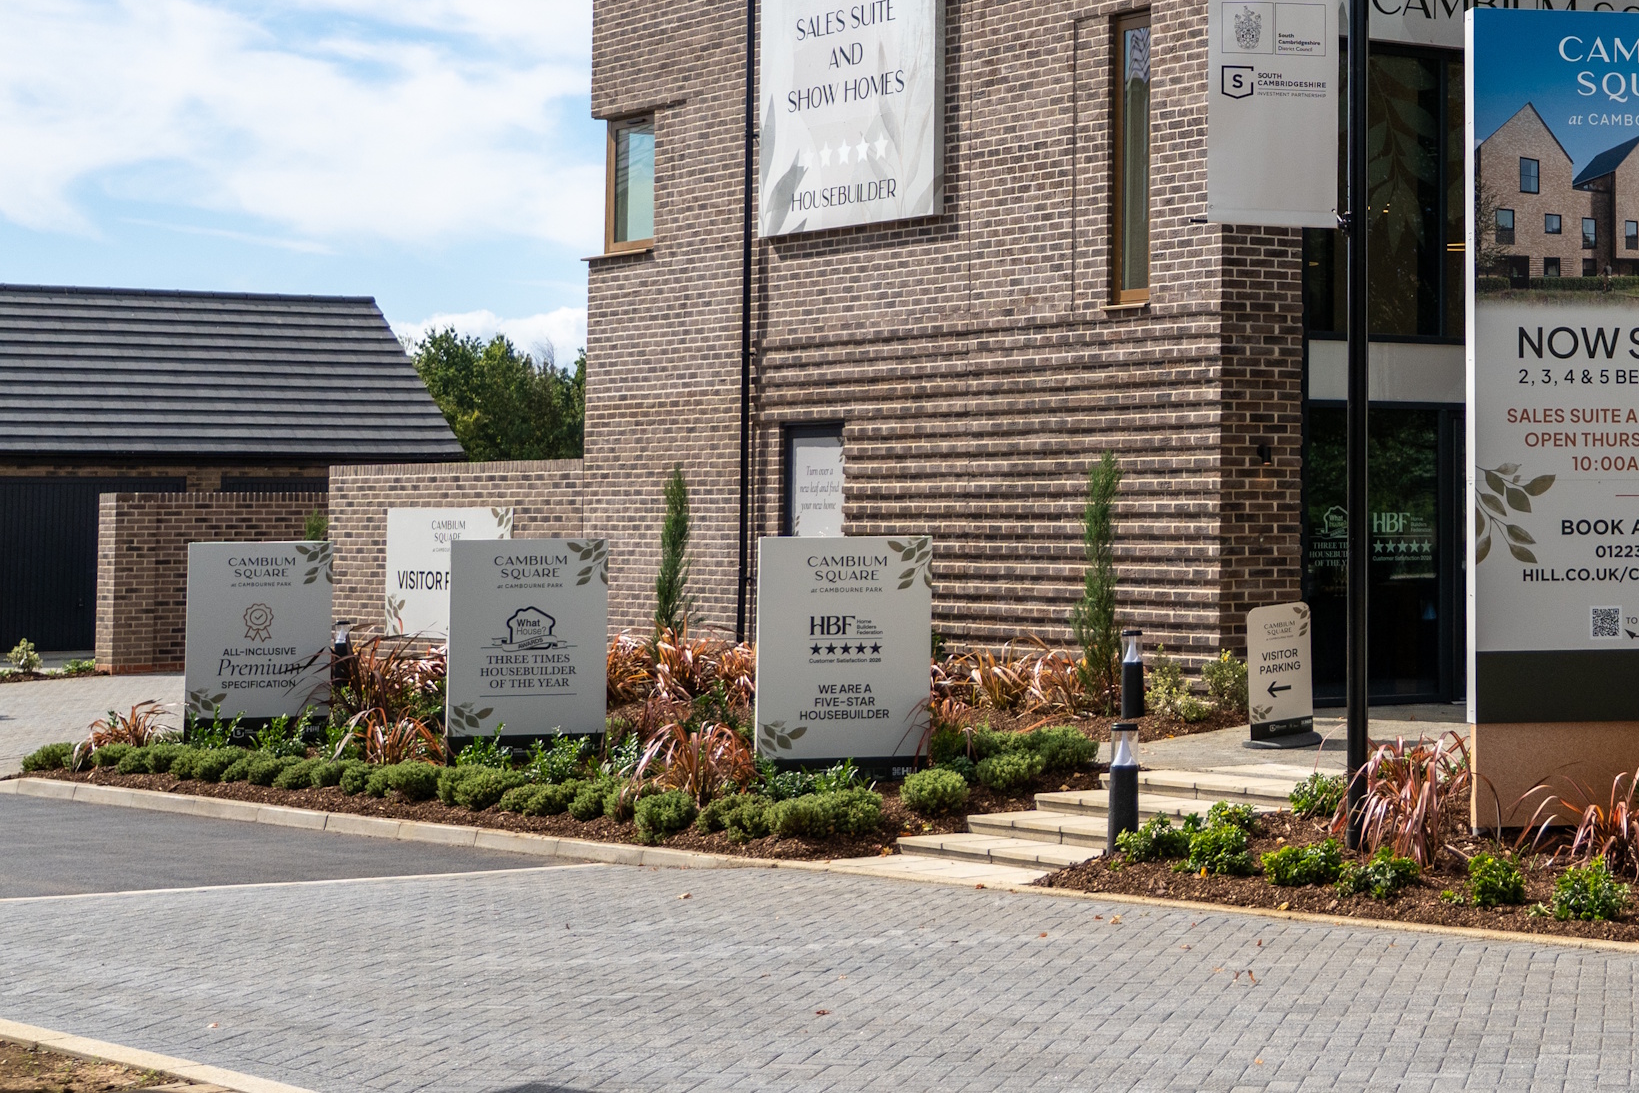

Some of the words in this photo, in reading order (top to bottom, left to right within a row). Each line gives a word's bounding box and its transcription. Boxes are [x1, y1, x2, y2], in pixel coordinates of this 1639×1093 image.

[796, 10, 845, 41] SALES
[828, 42, 863, 69] AND
[1233, 74, 1243, 88] S
[1258, 80, 1326, 88] CAMBRIDGESHIRE
[788, 82, 838, 113] SHOW
[845, 70, 904, 101] HOMES
[1568, 114, 1583, 125] at
[792, 178, 896, 211] HOUSEBUILDER
[1518, 326, 1620, 359] NOW
[1519, 370, 1535, 386] 2,
[1541, 370, 1558, 386] 3,
[1564, 370, 1575, 384] 4
[1581, 370, 1593, 384] &
[1600, 370, 1610, 384] 5
[1507, 408, 1565, 424] SALES
[1570, 409, 1621, 424] SUITE
[1525, 432, 1577, 448] OPEN
[806, 466, 818, 476] Turn
[431, 520, 466, 531] CAMBIUM
[1373, 513, 1410, 532] HBF
[1561, 519, 1624, 536] BOOK
[228, 557, 296, 566] CAMBIUM
[494, 556, 568, 566] CAMBIUM
[808, 556, 887, 567] CAMBIUM
[234, 568, 289, 579] SQUARE
[501, 568, 560, 579] SQUARE
[815, 570, 879, 583] SQUARE
[398, 570, 442, 590] VISITOR
[517, 619, 540, 627] What
[810, 616, 855, 635] HBF
[1264, 620, 1295, 629] CAMBIUM
[516, 627, 546, 635] House?
[518, 638, 543, 649] AWARDS
[223, 647, 296, 656] ALL-INCLUSIVE
[1262, 648, 1298, 661] VISITOR
[487, 655, 529, 664] THREE
[532, 654, 570, 663] TIMES
[217, 658, 301, 676] Premium
[480, 666, 576, 676] HOUSEBUILDER
[1260, 661, 1300, 675] PARKING
[222, 680, 296, 688] SPECIFICATION
[490, 679, 506, 688] OF
[509, 679, 534, 688] THE
[537, 678, 570, 687] YEAR
[818, 684, 837, 694] WE
[839, 684, 862, 693] ARE
[864, 684, 871, 693] A
[814, 697, 875, 707] FIVE-STAR
[800, 709, 889, 720] HOUSEBUILDER
